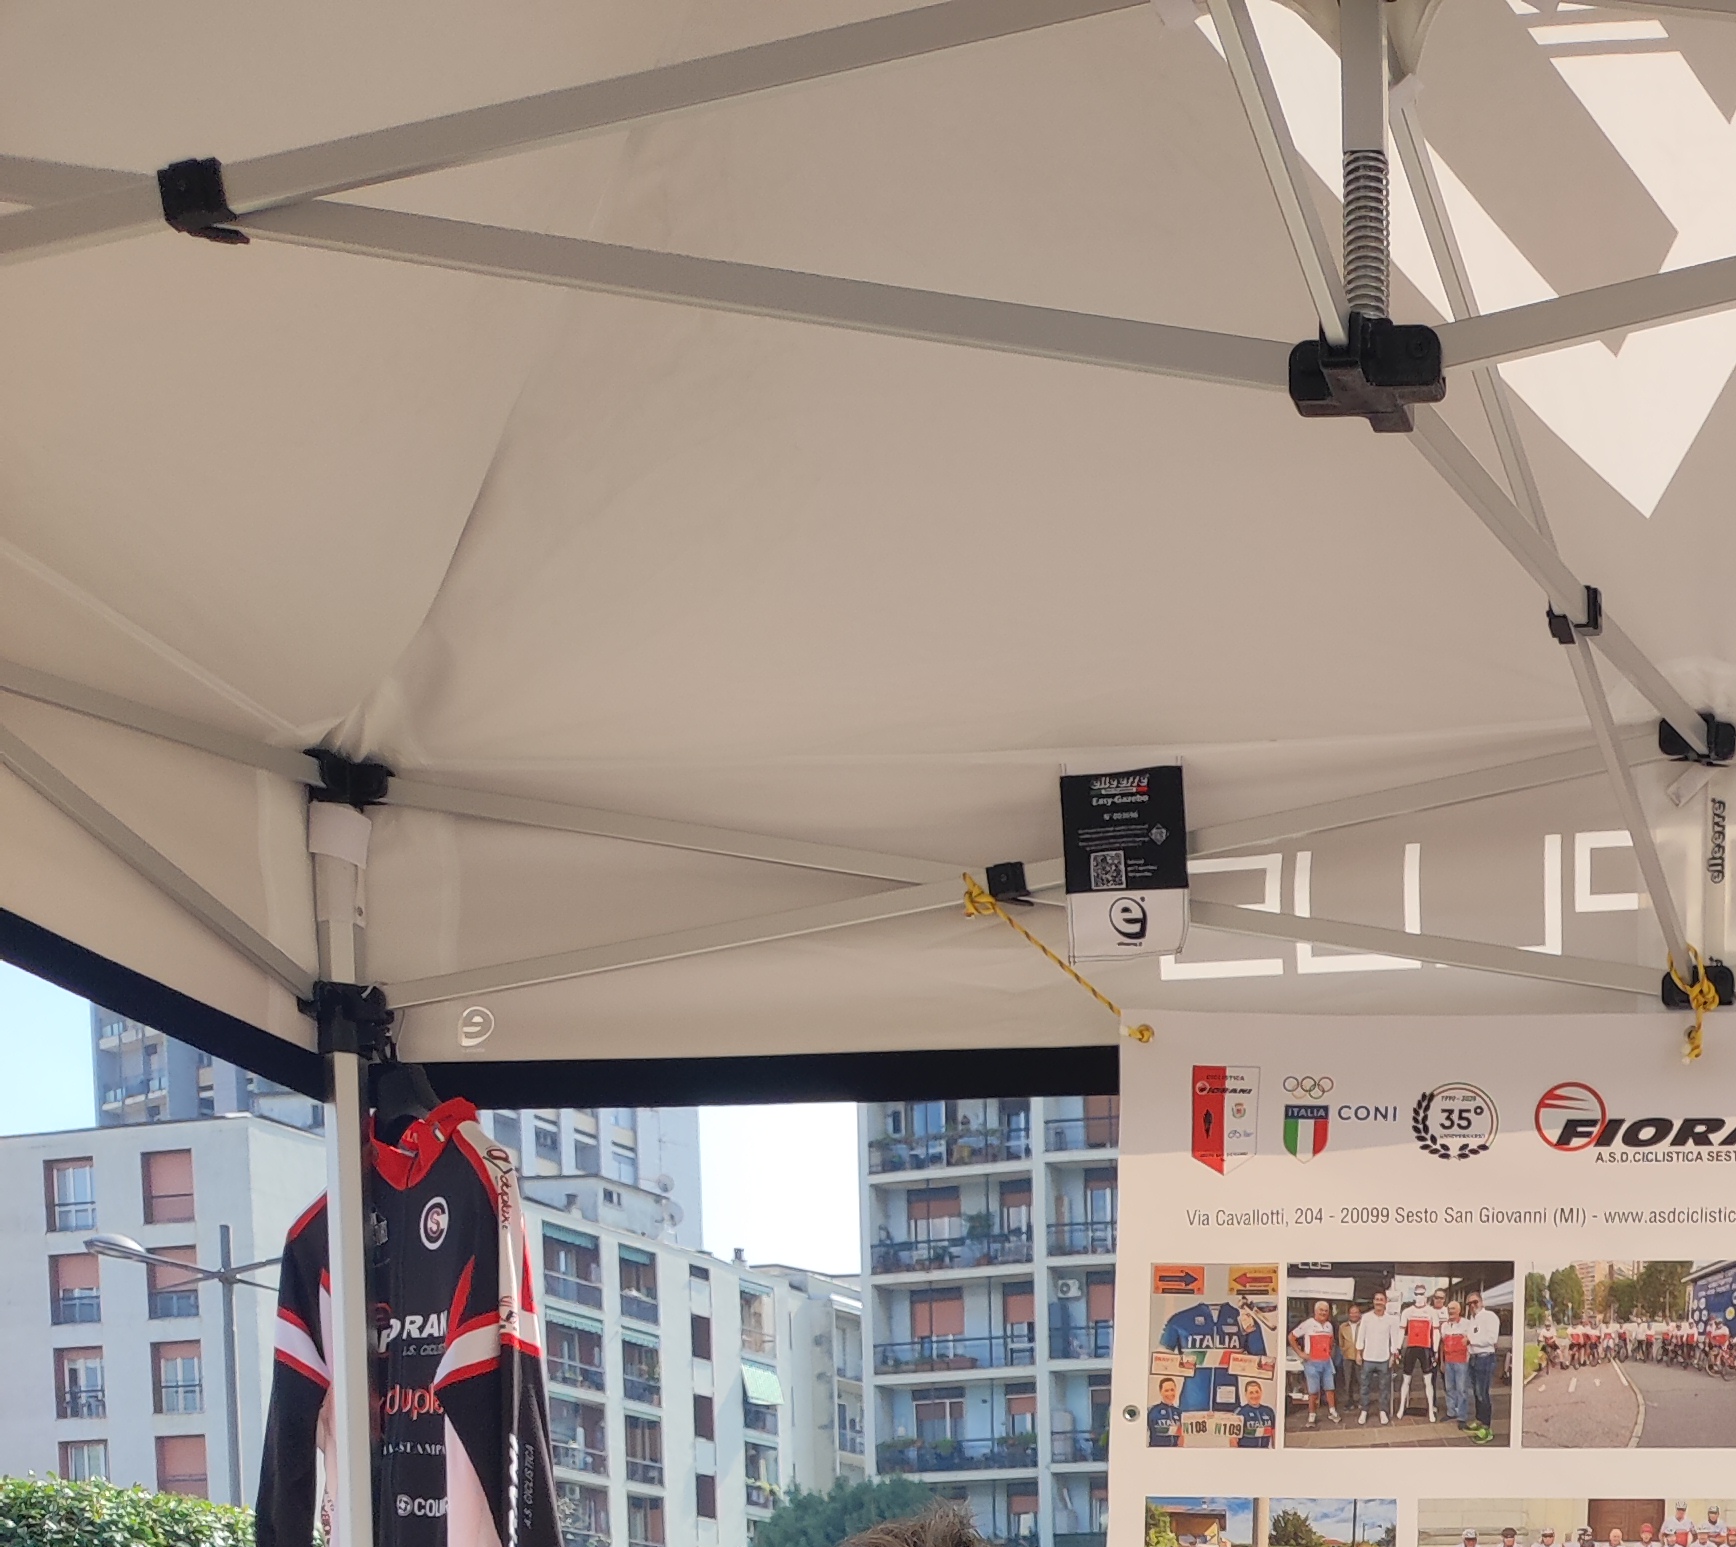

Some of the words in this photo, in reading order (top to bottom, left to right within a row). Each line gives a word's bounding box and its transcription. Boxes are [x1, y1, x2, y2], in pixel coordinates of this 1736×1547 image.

[1288, 1107, 1326, 1118] ITALIA
[1337, 1105, 1398, 1122] CONI
[1186, 1209, 1210, 1226] Via
[1215, 1208, 1290, 1228] Cavallotti,
[1294, 1207, 1323, 1225] 204
[1340, 1207, 1390, 1224] 20099
[1394, 1207, 1438, 1225] Sesto
[1443, 1207, 1474, 1224] San
[1478, 1206, 1547, 1225] Giovanni
[1552, 1206, 1586, 1227] (MI)
[1187, 1335, 1240, 1348] ITALIA
